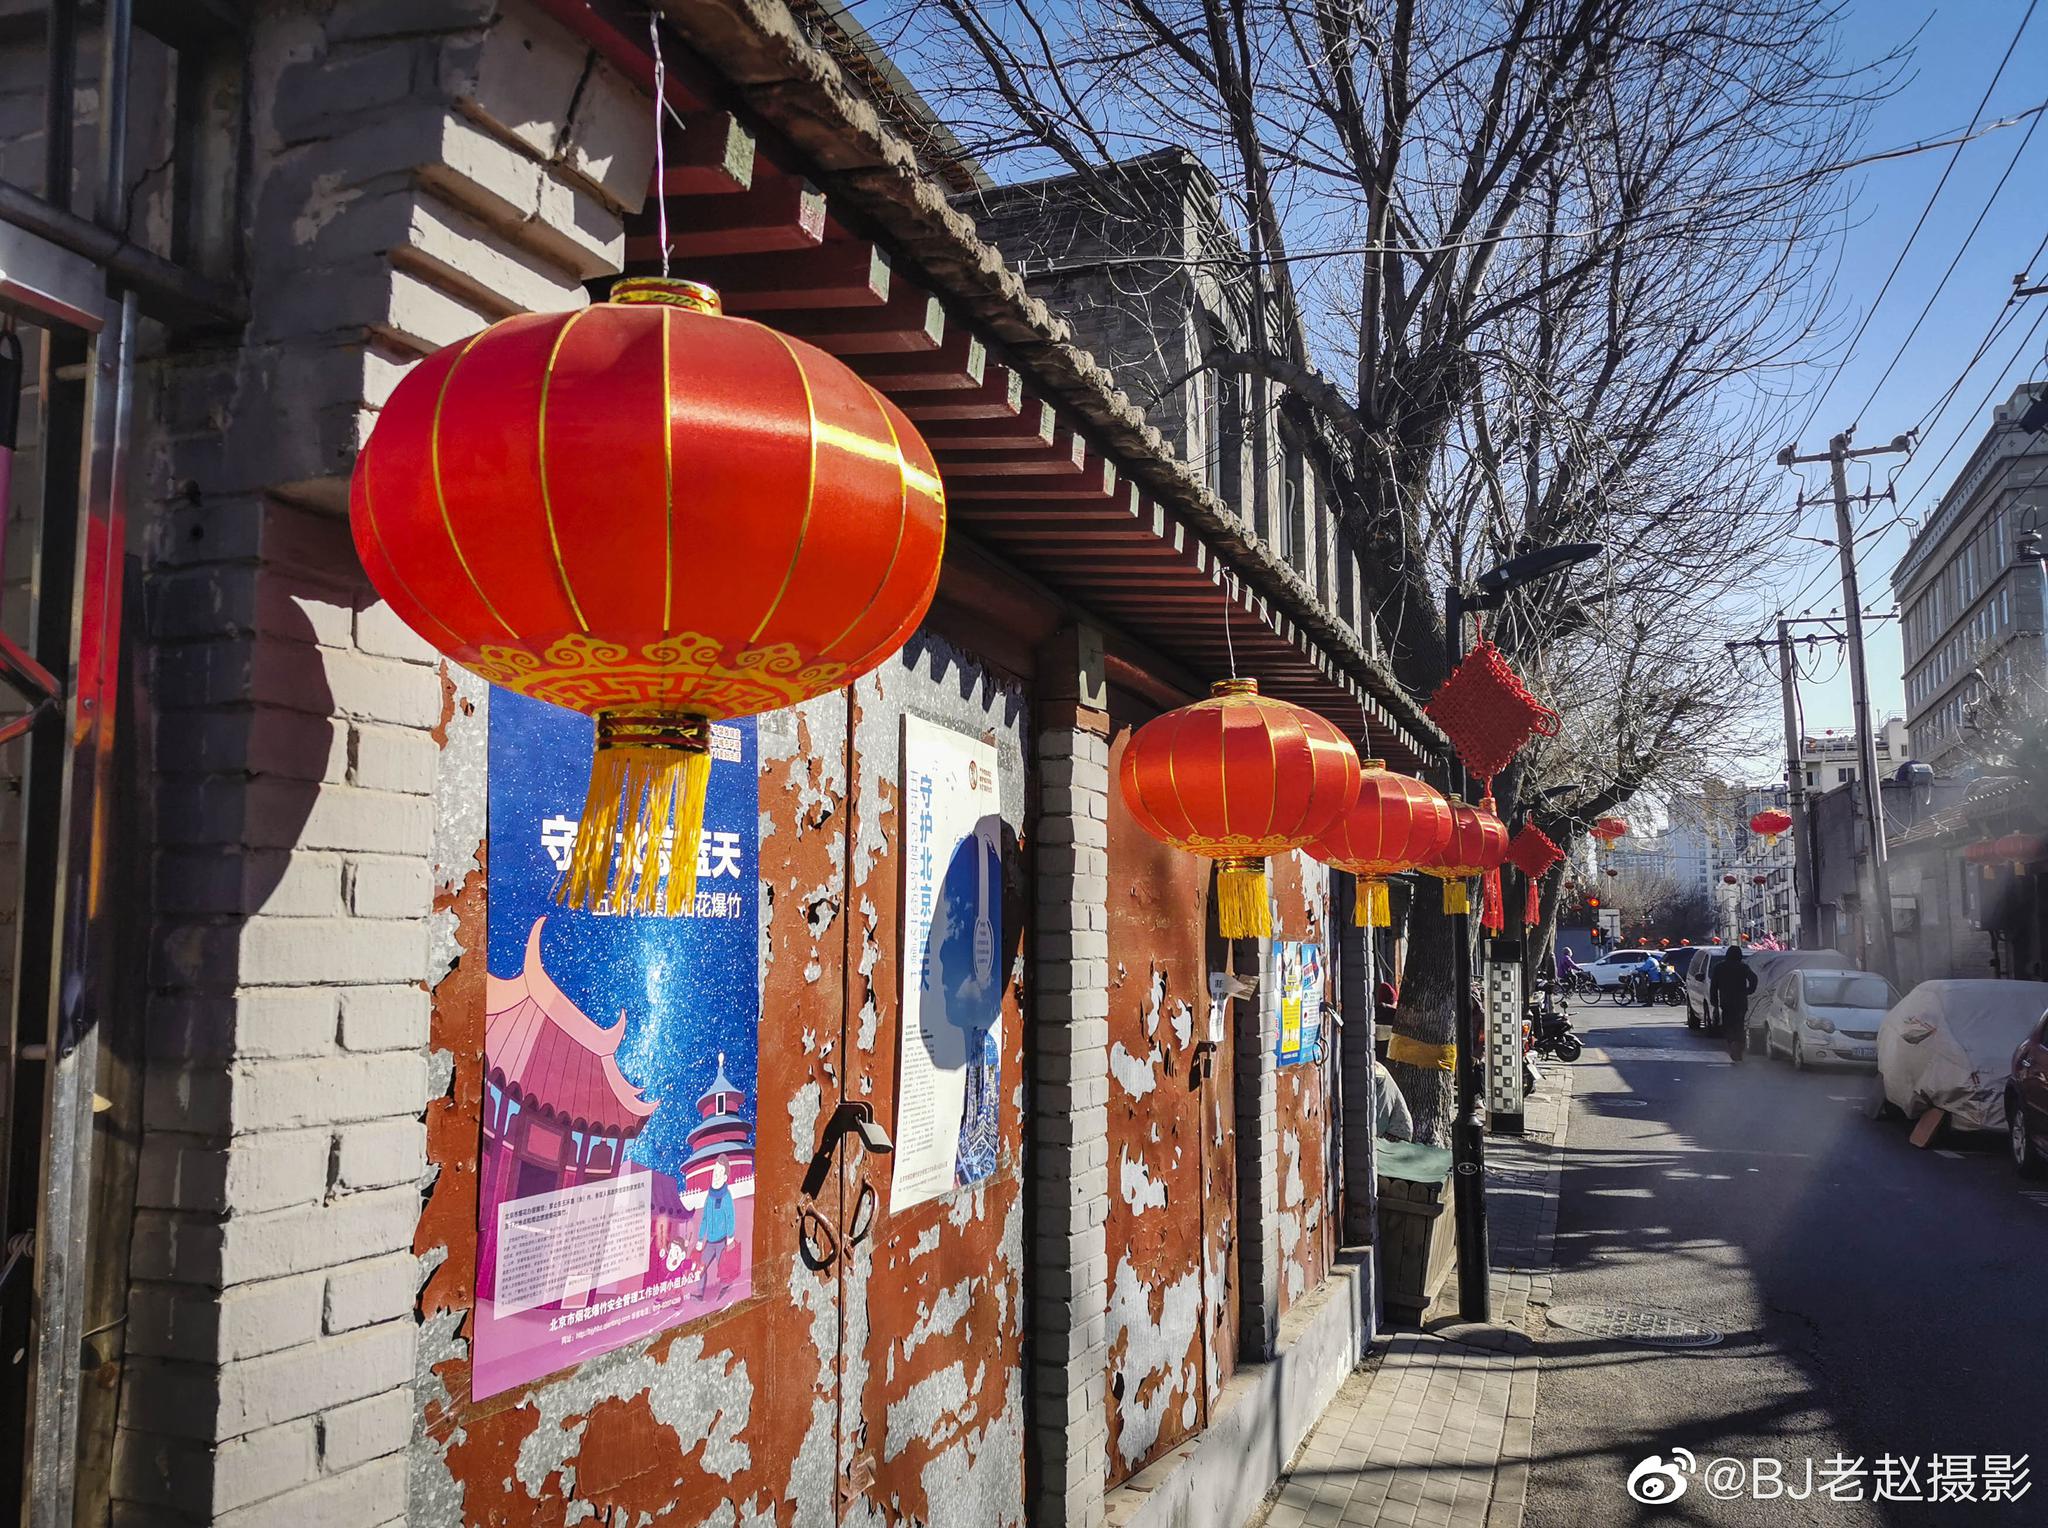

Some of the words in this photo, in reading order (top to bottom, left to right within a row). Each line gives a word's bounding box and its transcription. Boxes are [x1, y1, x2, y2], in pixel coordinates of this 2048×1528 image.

[919, 774, 933, 991] 守护北京蓝天
